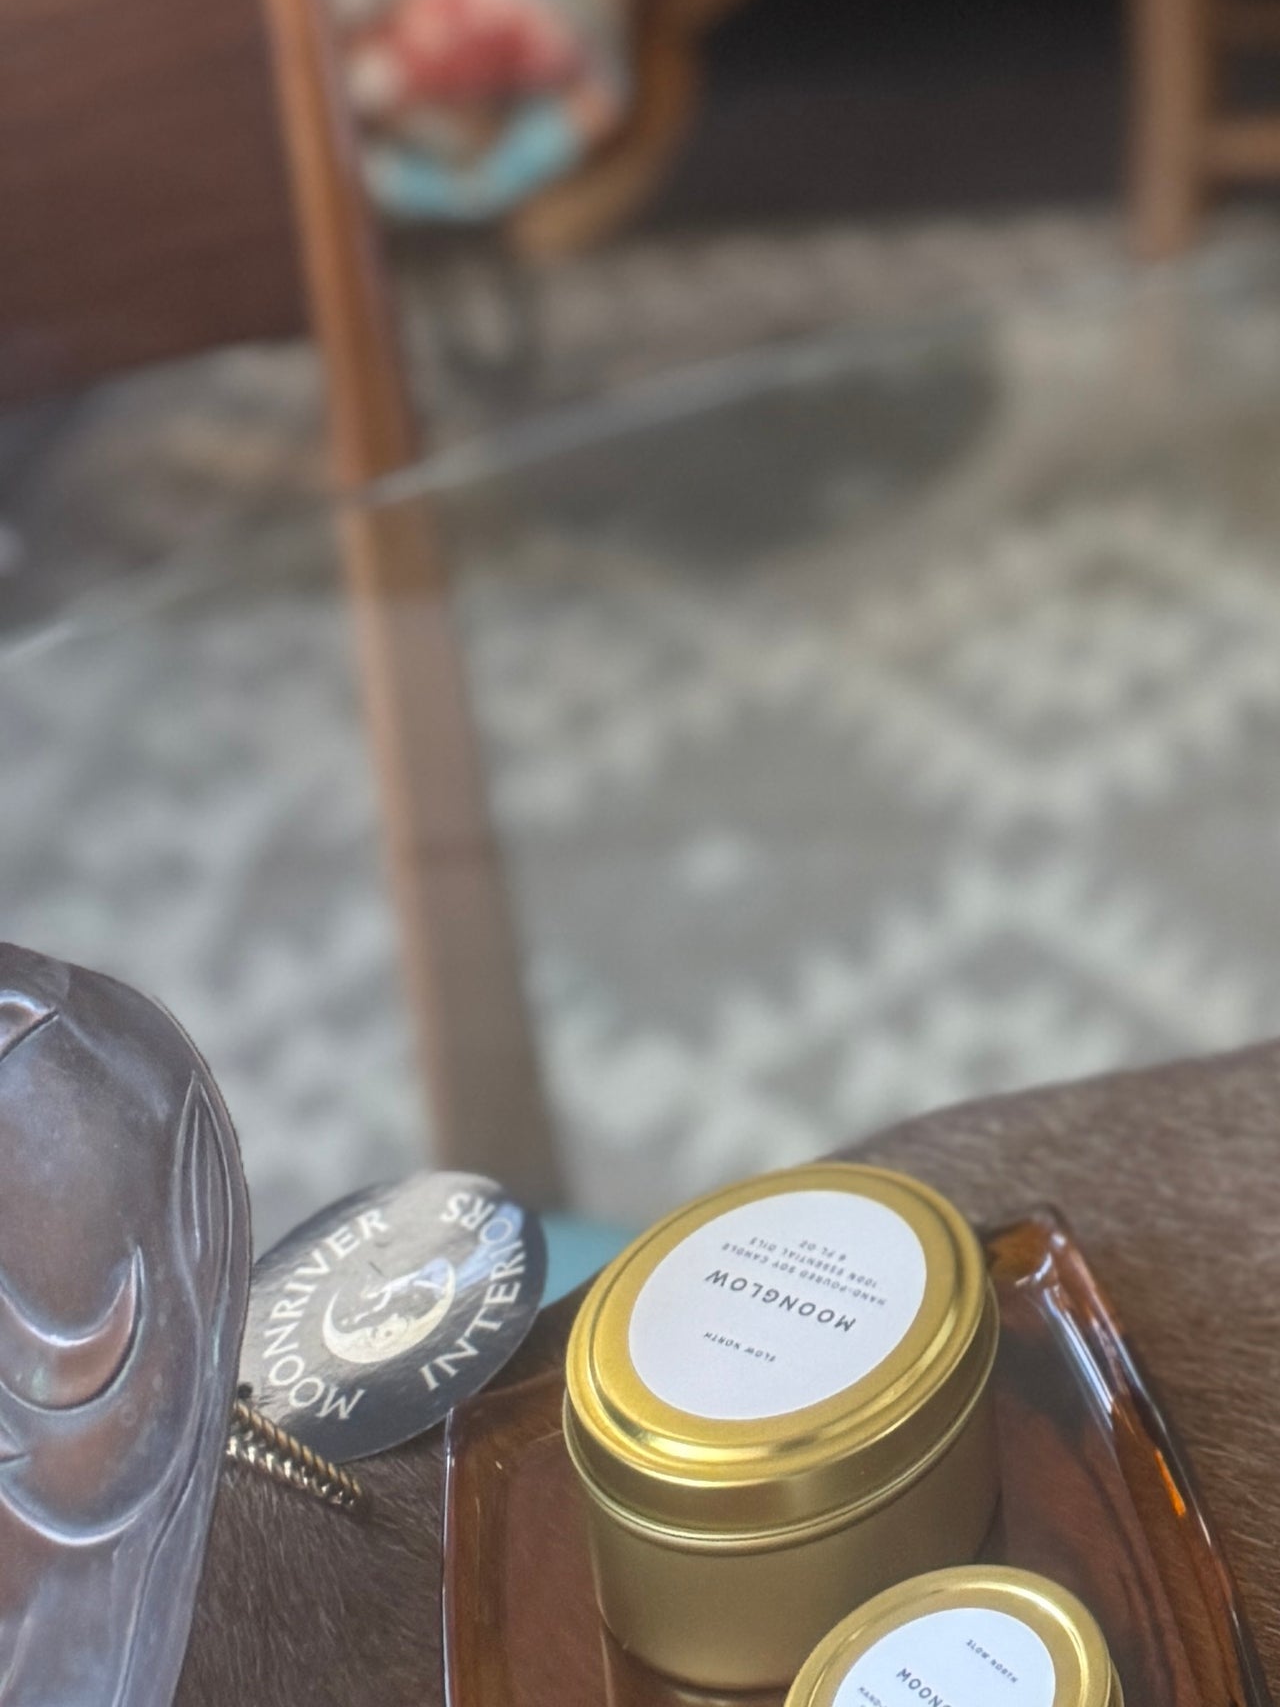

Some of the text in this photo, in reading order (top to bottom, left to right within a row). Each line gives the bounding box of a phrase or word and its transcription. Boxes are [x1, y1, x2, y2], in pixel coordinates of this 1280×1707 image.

[748, 1236, 778, 1254] OILS
[781, 1247, 845, 1277] ESSENTIAL
[798, 1239, 817, 1252] OZ
[820, 1246, 837, 1259] FL
[418, 1191, 526, 1392] INTERIORS
[721, 1242, 887, 1306] HAND-POURED SOY CANDLE
[261, 1206, 392, 1420] MOONRIVER
[704, 1269, 857, 1333] MOONGLOW
[703, 1331, 741, 1351] NORTH
[965, 1638, 1019, 1684] SLOW NORTH
